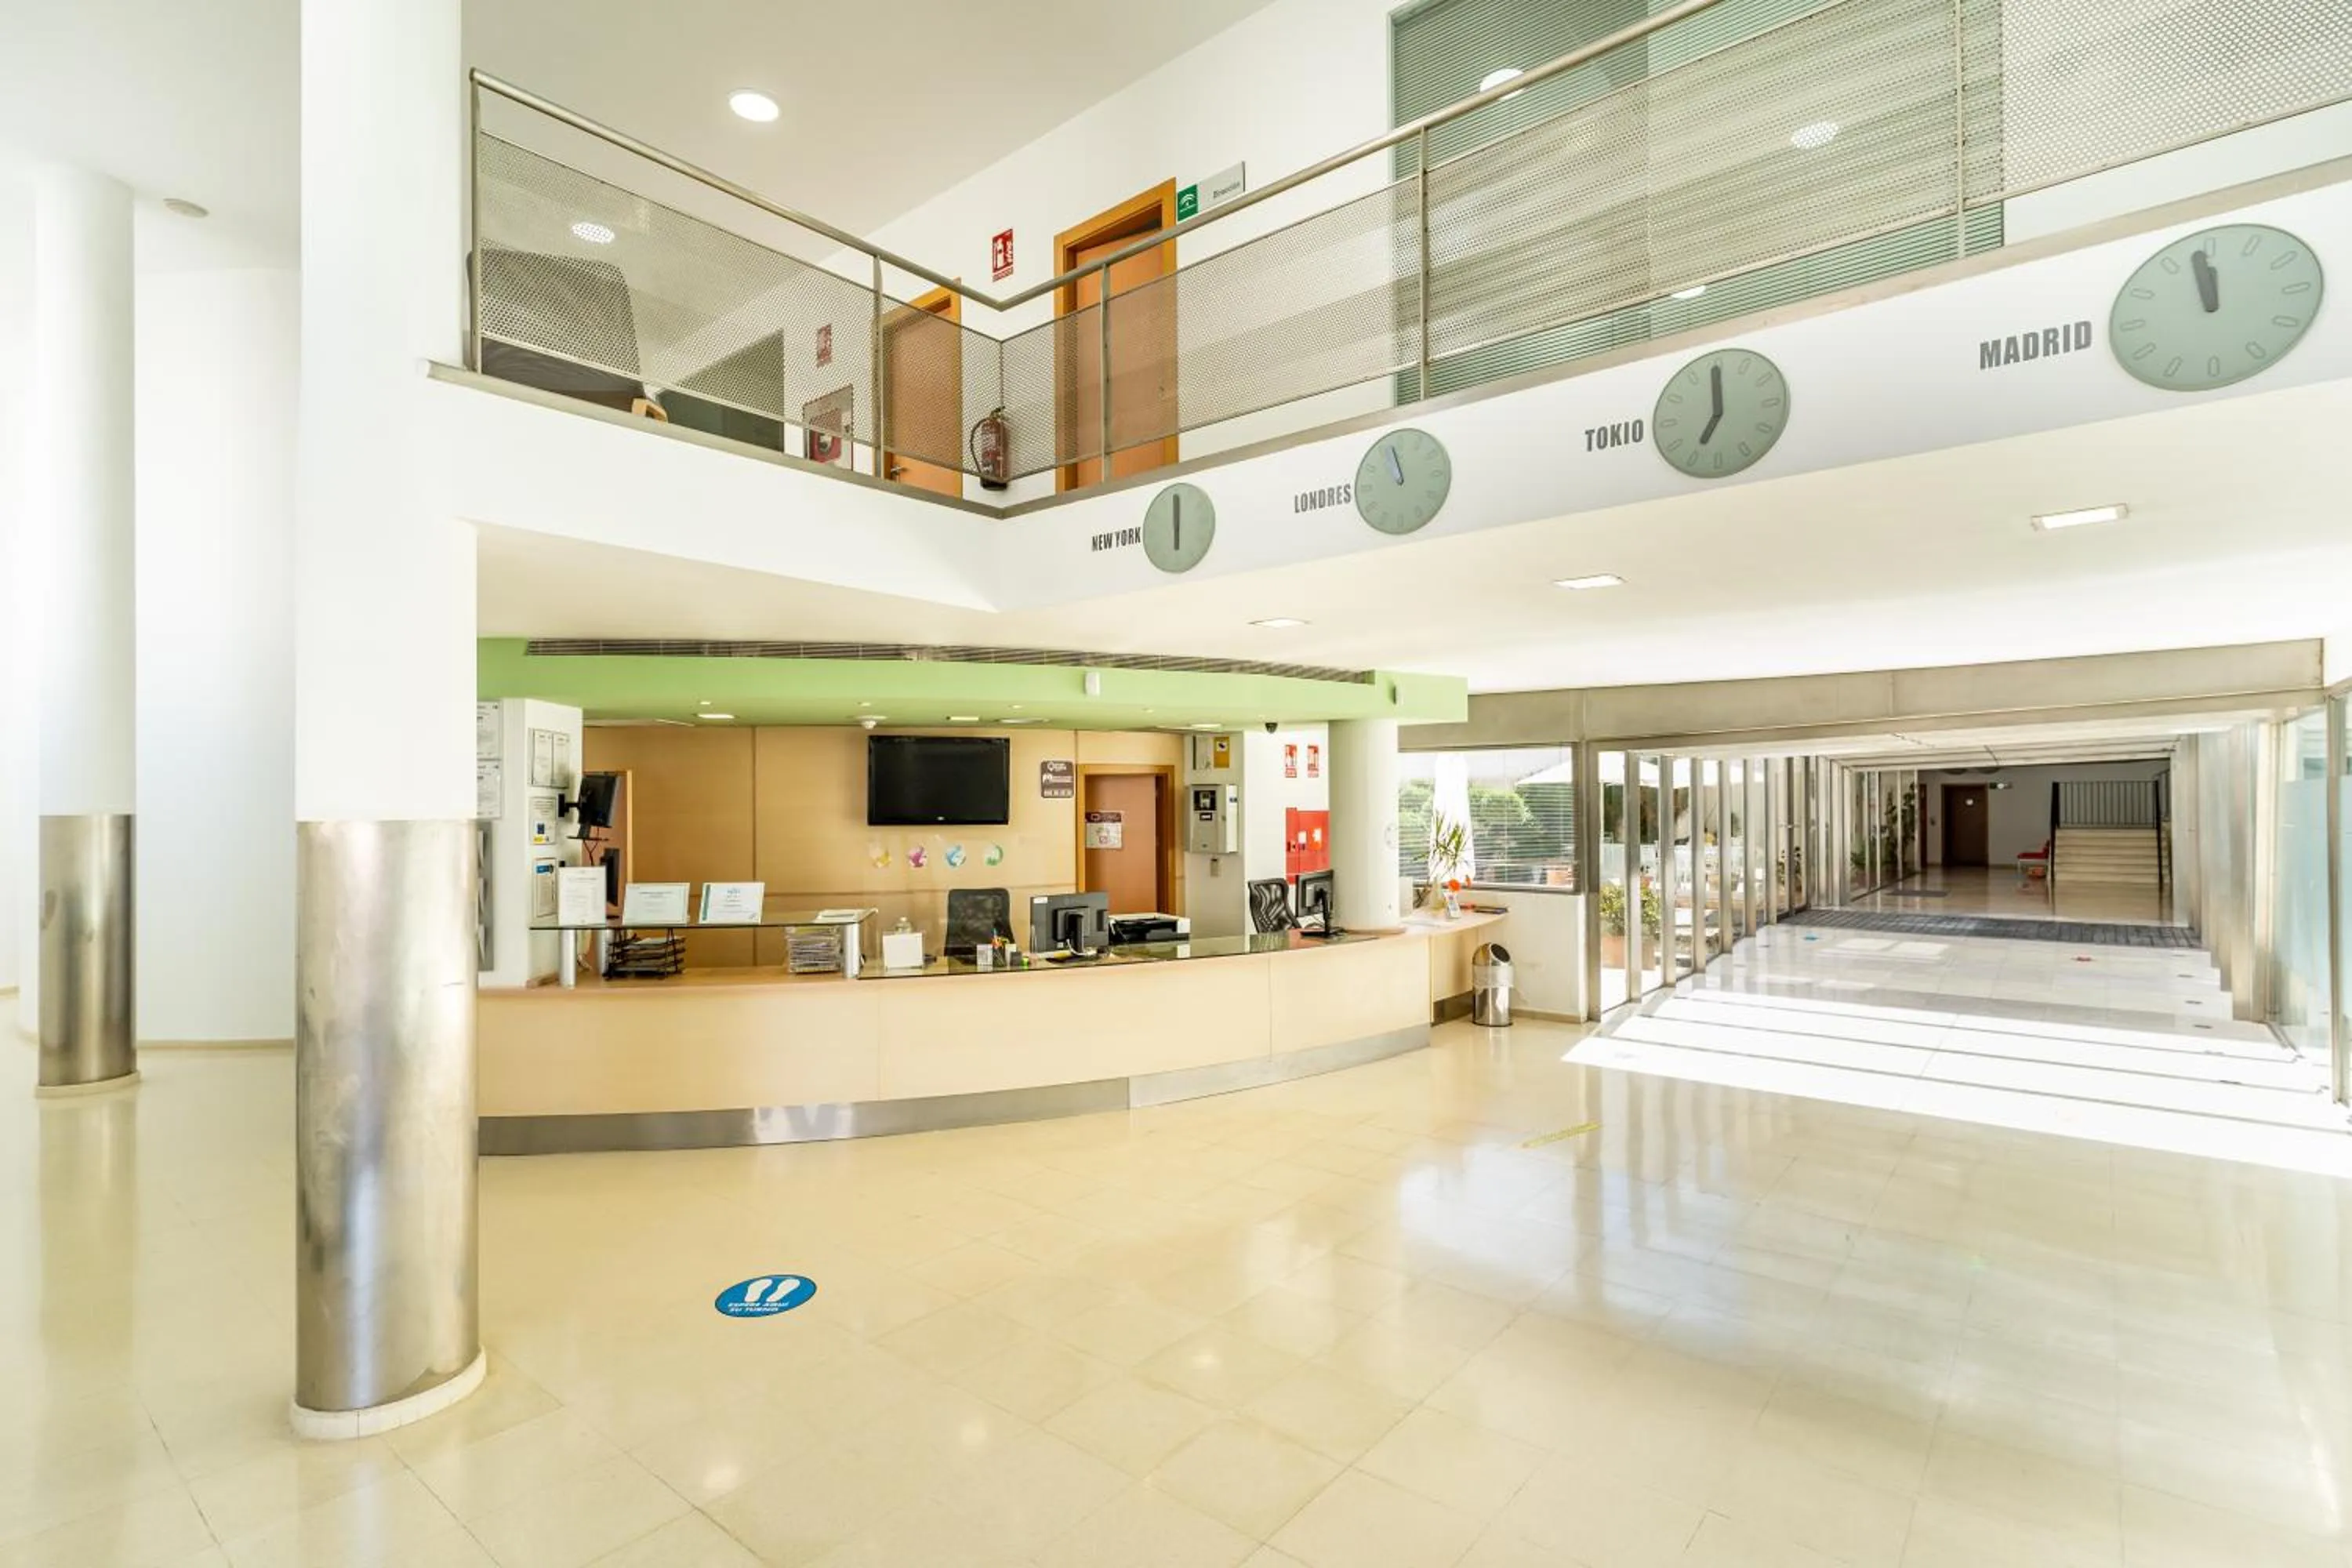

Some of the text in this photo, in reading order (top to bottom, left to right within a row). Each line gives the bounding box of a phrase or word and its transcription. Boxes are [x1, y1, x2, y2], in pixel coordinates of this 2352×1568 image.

[1980, 320, 2092, 370] MADRID
[1584, 419, 1644, 452] TOKIO
[1294, 483, 1351, 513] LONDRES
[1091, 526, 1141, 552] NEW YORK
